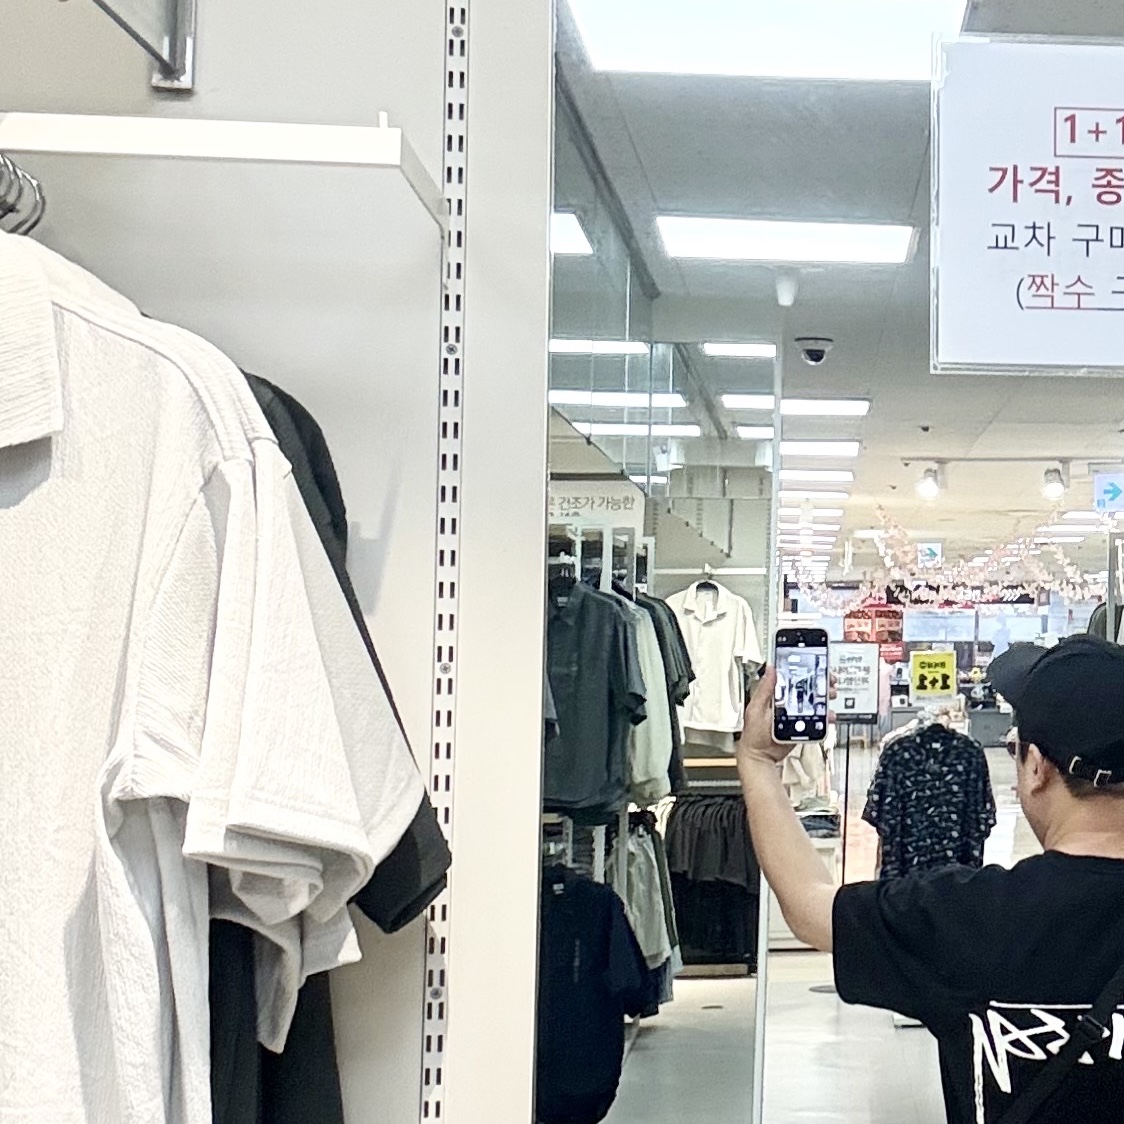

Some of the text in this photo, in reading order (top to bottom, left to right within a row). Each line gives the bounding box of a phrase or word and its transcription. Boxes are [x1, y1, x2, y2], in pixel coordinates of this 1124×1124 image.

[987, 163, 1074, 206] 가격,
[986, 221, 1056, 257] 교차
[1015, 272, 1096, 311] (짝수
